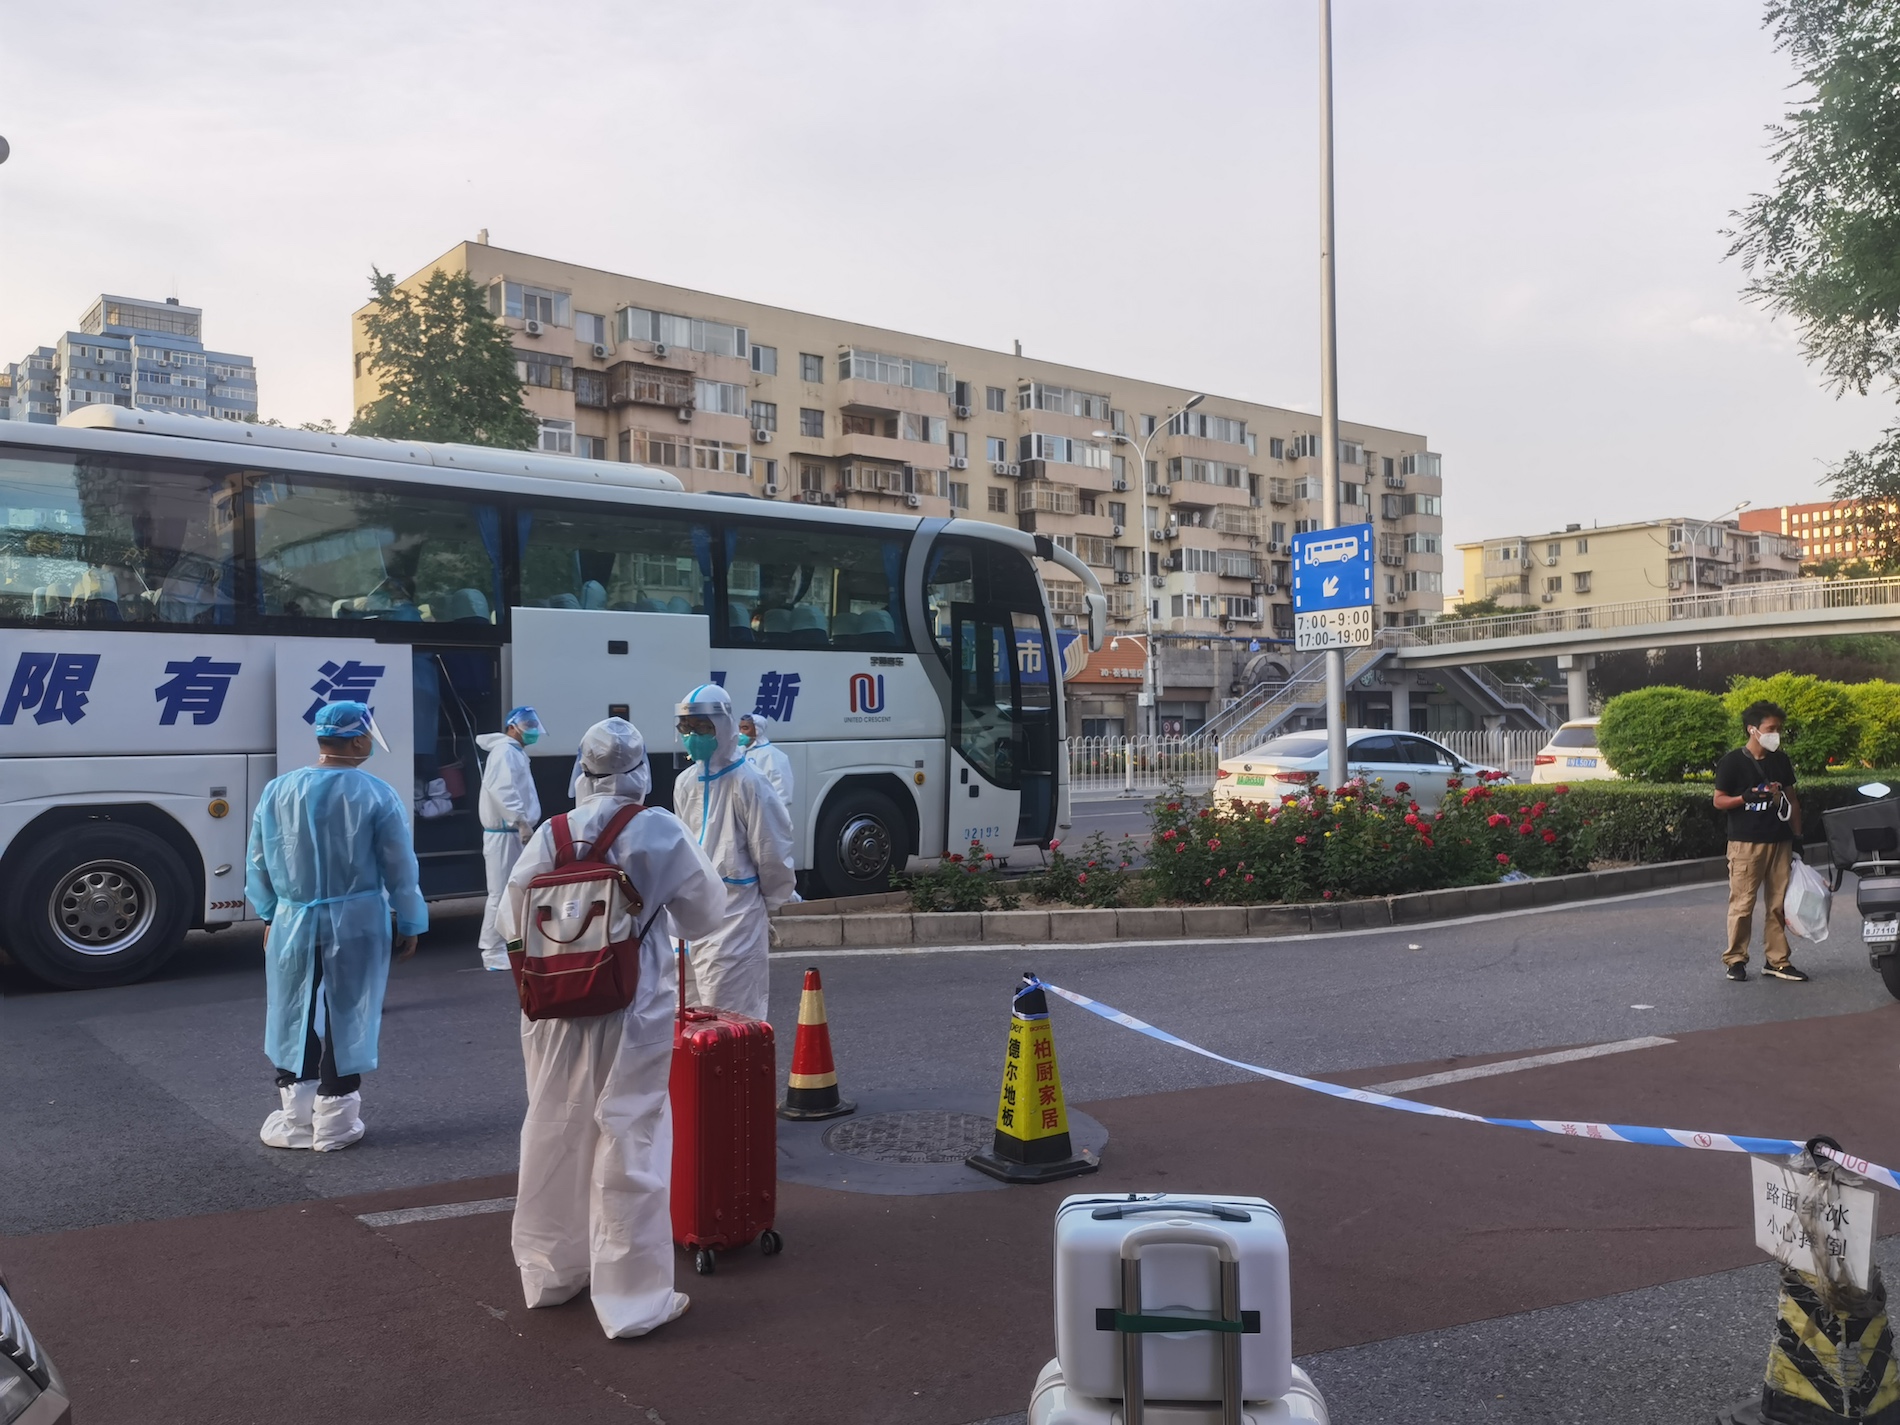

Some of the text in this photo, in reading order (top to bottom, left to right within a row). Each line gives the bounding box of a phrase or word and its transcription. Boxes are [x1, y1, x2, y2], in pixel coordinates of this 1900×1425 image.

[1001, 1037, 1021, 1129] 德尔地板
[1033, 1037, 1059, 1130] 柏厨家居
